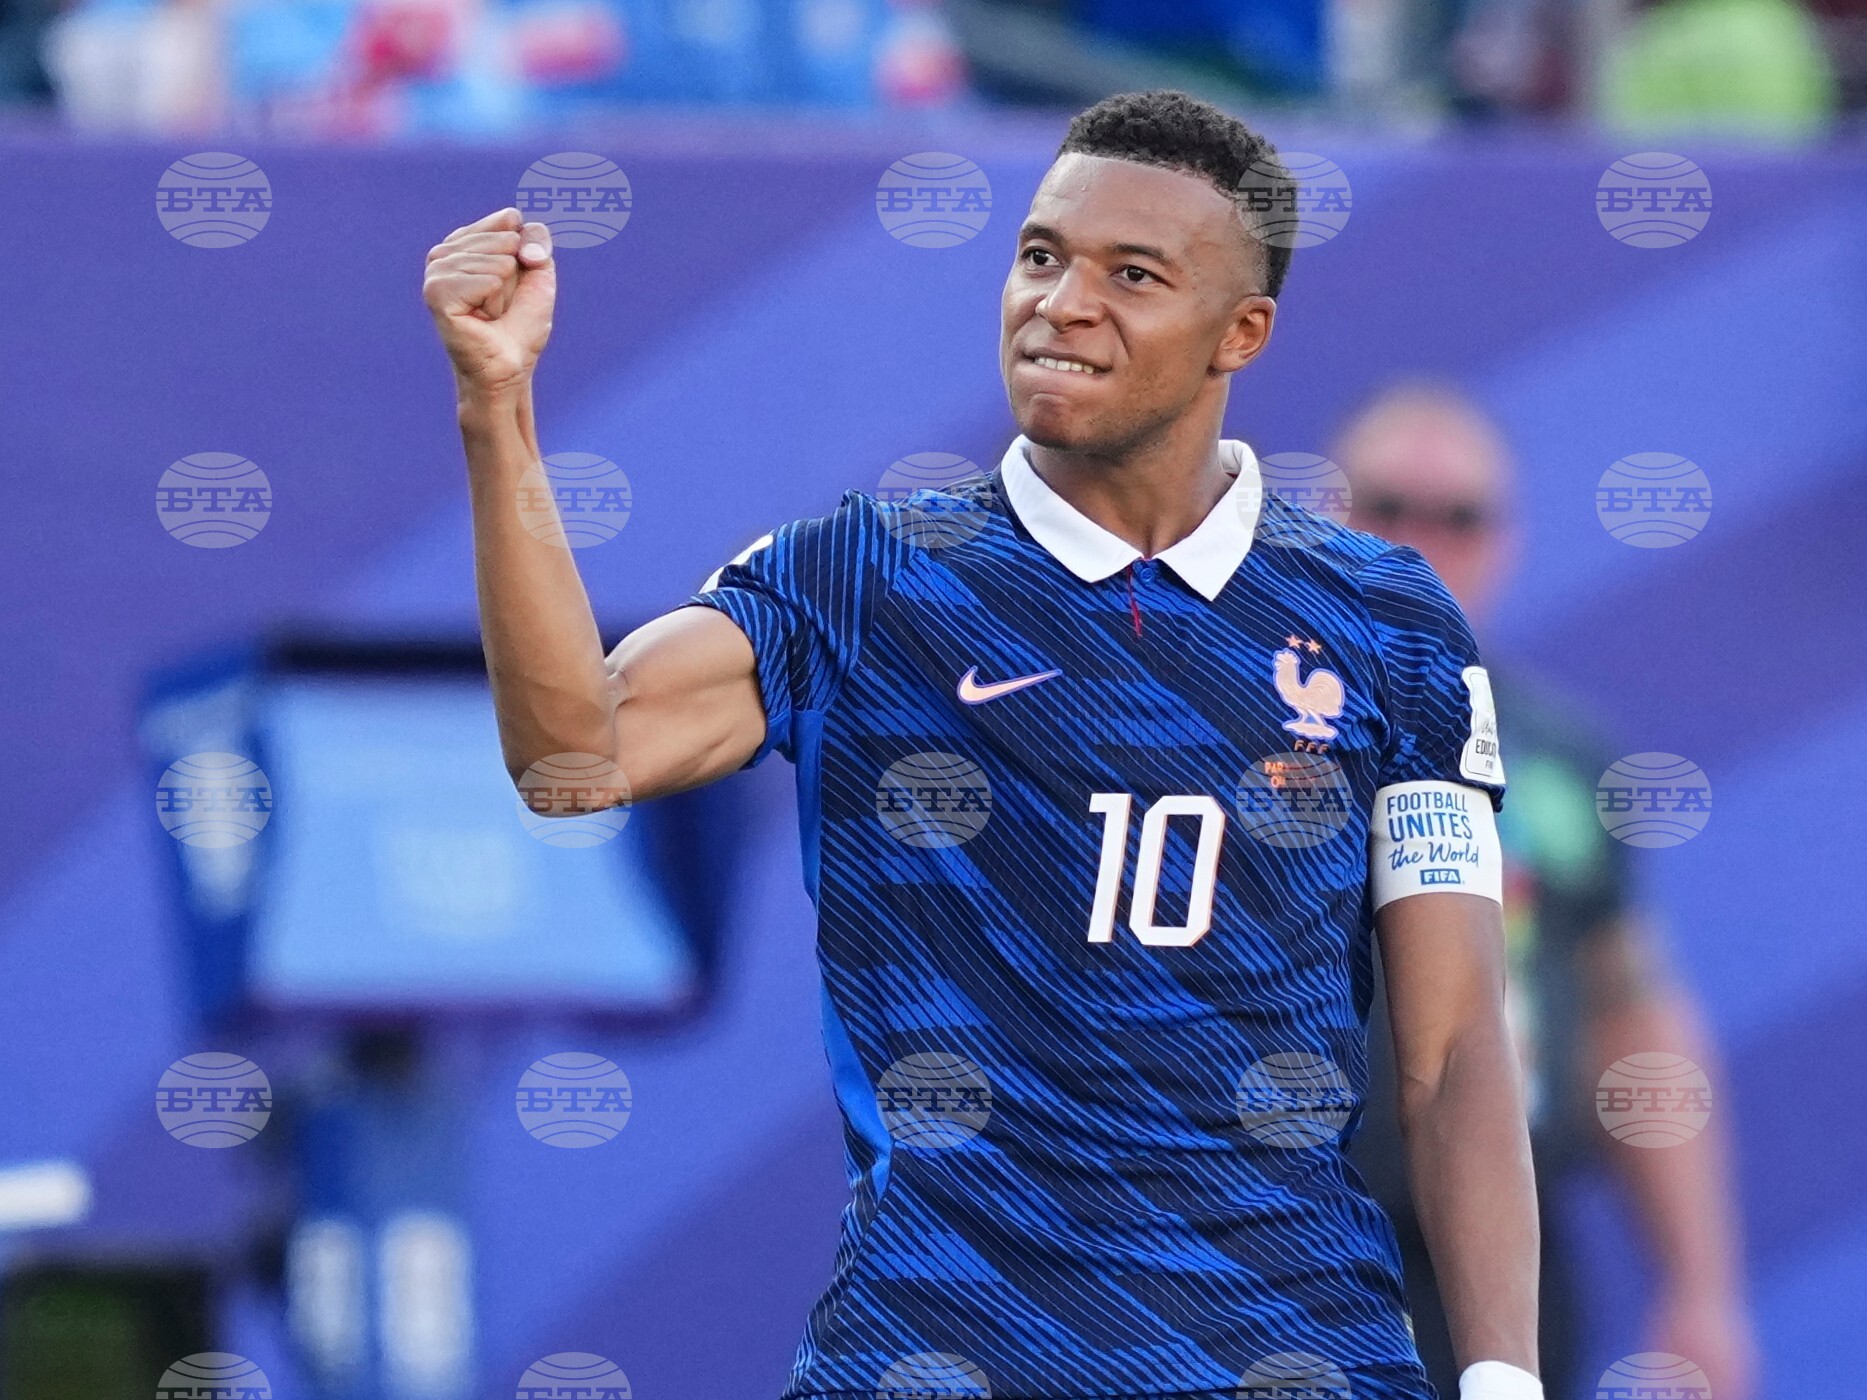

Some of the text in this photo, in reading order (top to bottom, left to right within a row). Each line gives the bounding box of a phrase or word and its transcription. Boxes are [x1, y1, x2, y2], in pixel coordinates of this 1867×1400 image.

[1387, 791, 1468, 815] FOOTBALL
[1388, 811, 1473, 843] UNITES
[1087, 793, 1226, 947] 10
[1387, 841, 1479, 870] the World
[1422, 869, 1460, 884] FIFA
